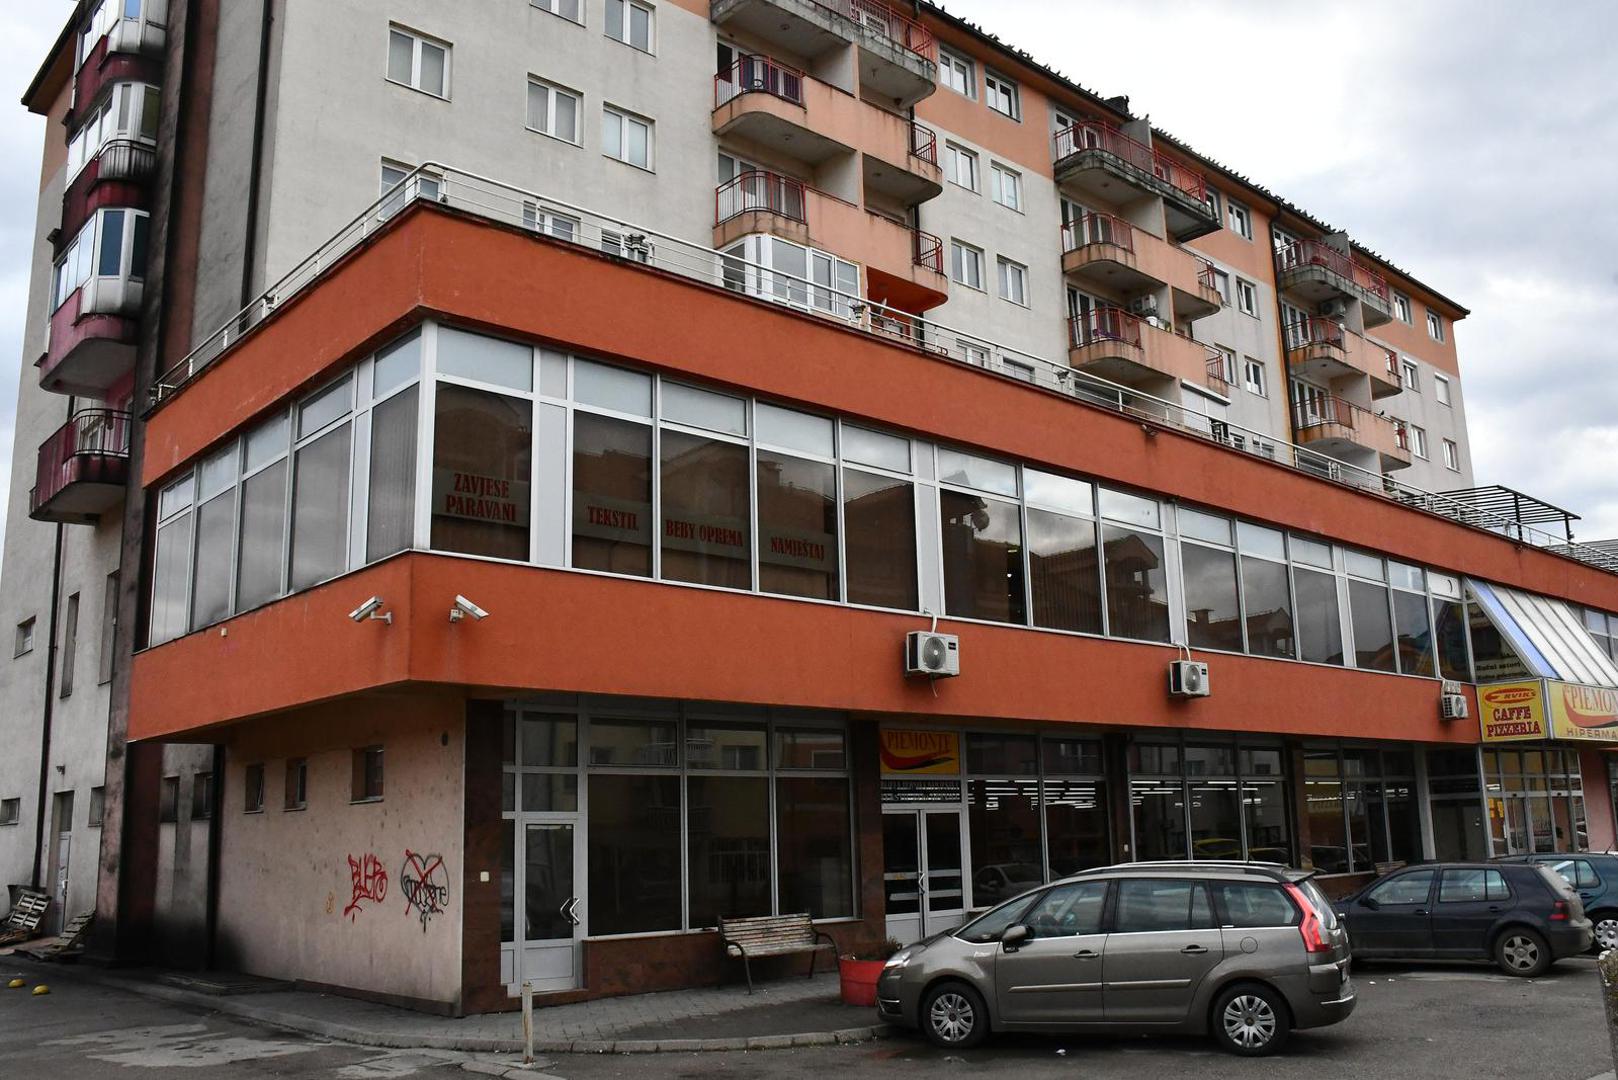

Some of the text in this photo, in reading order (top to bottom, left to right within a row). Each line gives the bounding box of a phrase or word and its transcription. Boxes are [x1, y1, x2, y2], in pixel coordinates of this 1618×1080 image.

[454, 473, 510, 499] ZAVJESE
[445, 493, 517, 521] PARAVANI
[587, 505, 640, 531] TEKSTIL
[665, 519, 744, 547] BEBY OPREMA
[1492, 706, 1532, 722] CAFFE
[887, 731, 953, 752] PIEMONTE
[1486, 720, 1542, 738] PIZZERIA
